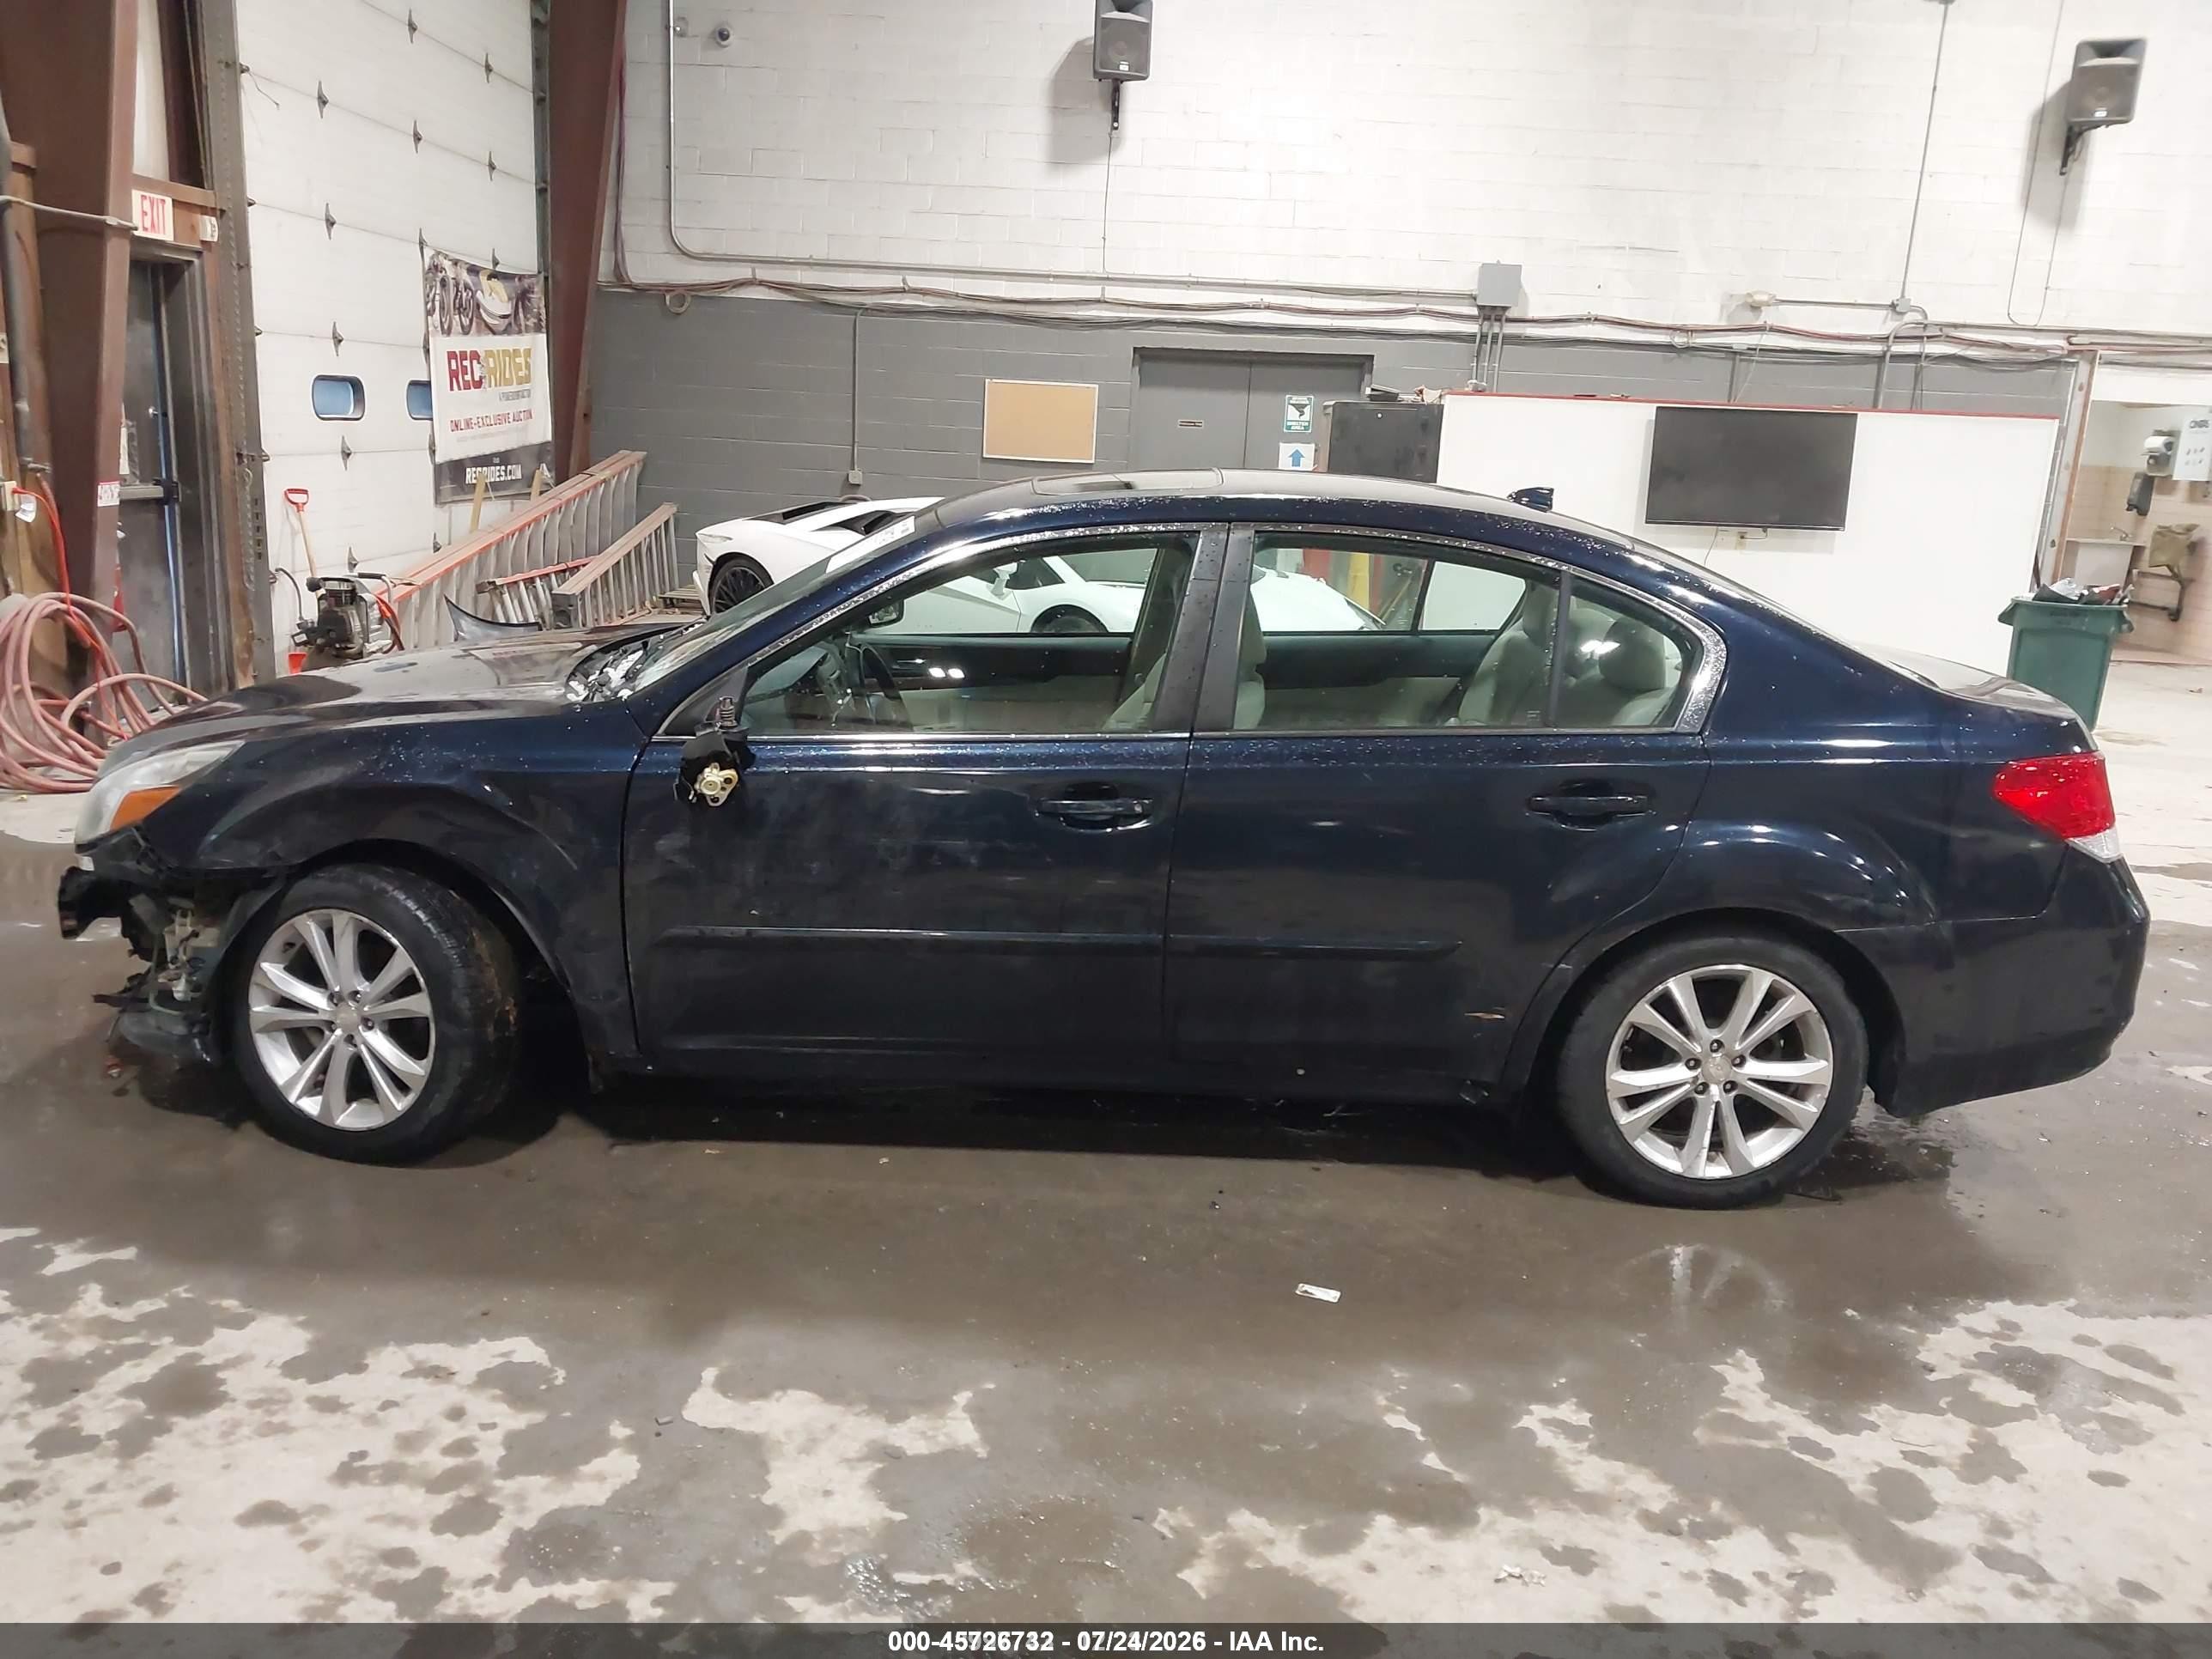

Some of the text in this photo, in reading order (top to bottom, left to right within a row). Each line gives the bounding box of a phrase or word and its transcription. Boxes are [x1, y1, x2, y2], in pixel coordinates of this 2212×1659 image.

[140, 194, 166, 235] EXIT
[447, 348, 532, 392] REC RIDES
[450, 413, 511, 432] ONLINE-EXCLUSIVE
